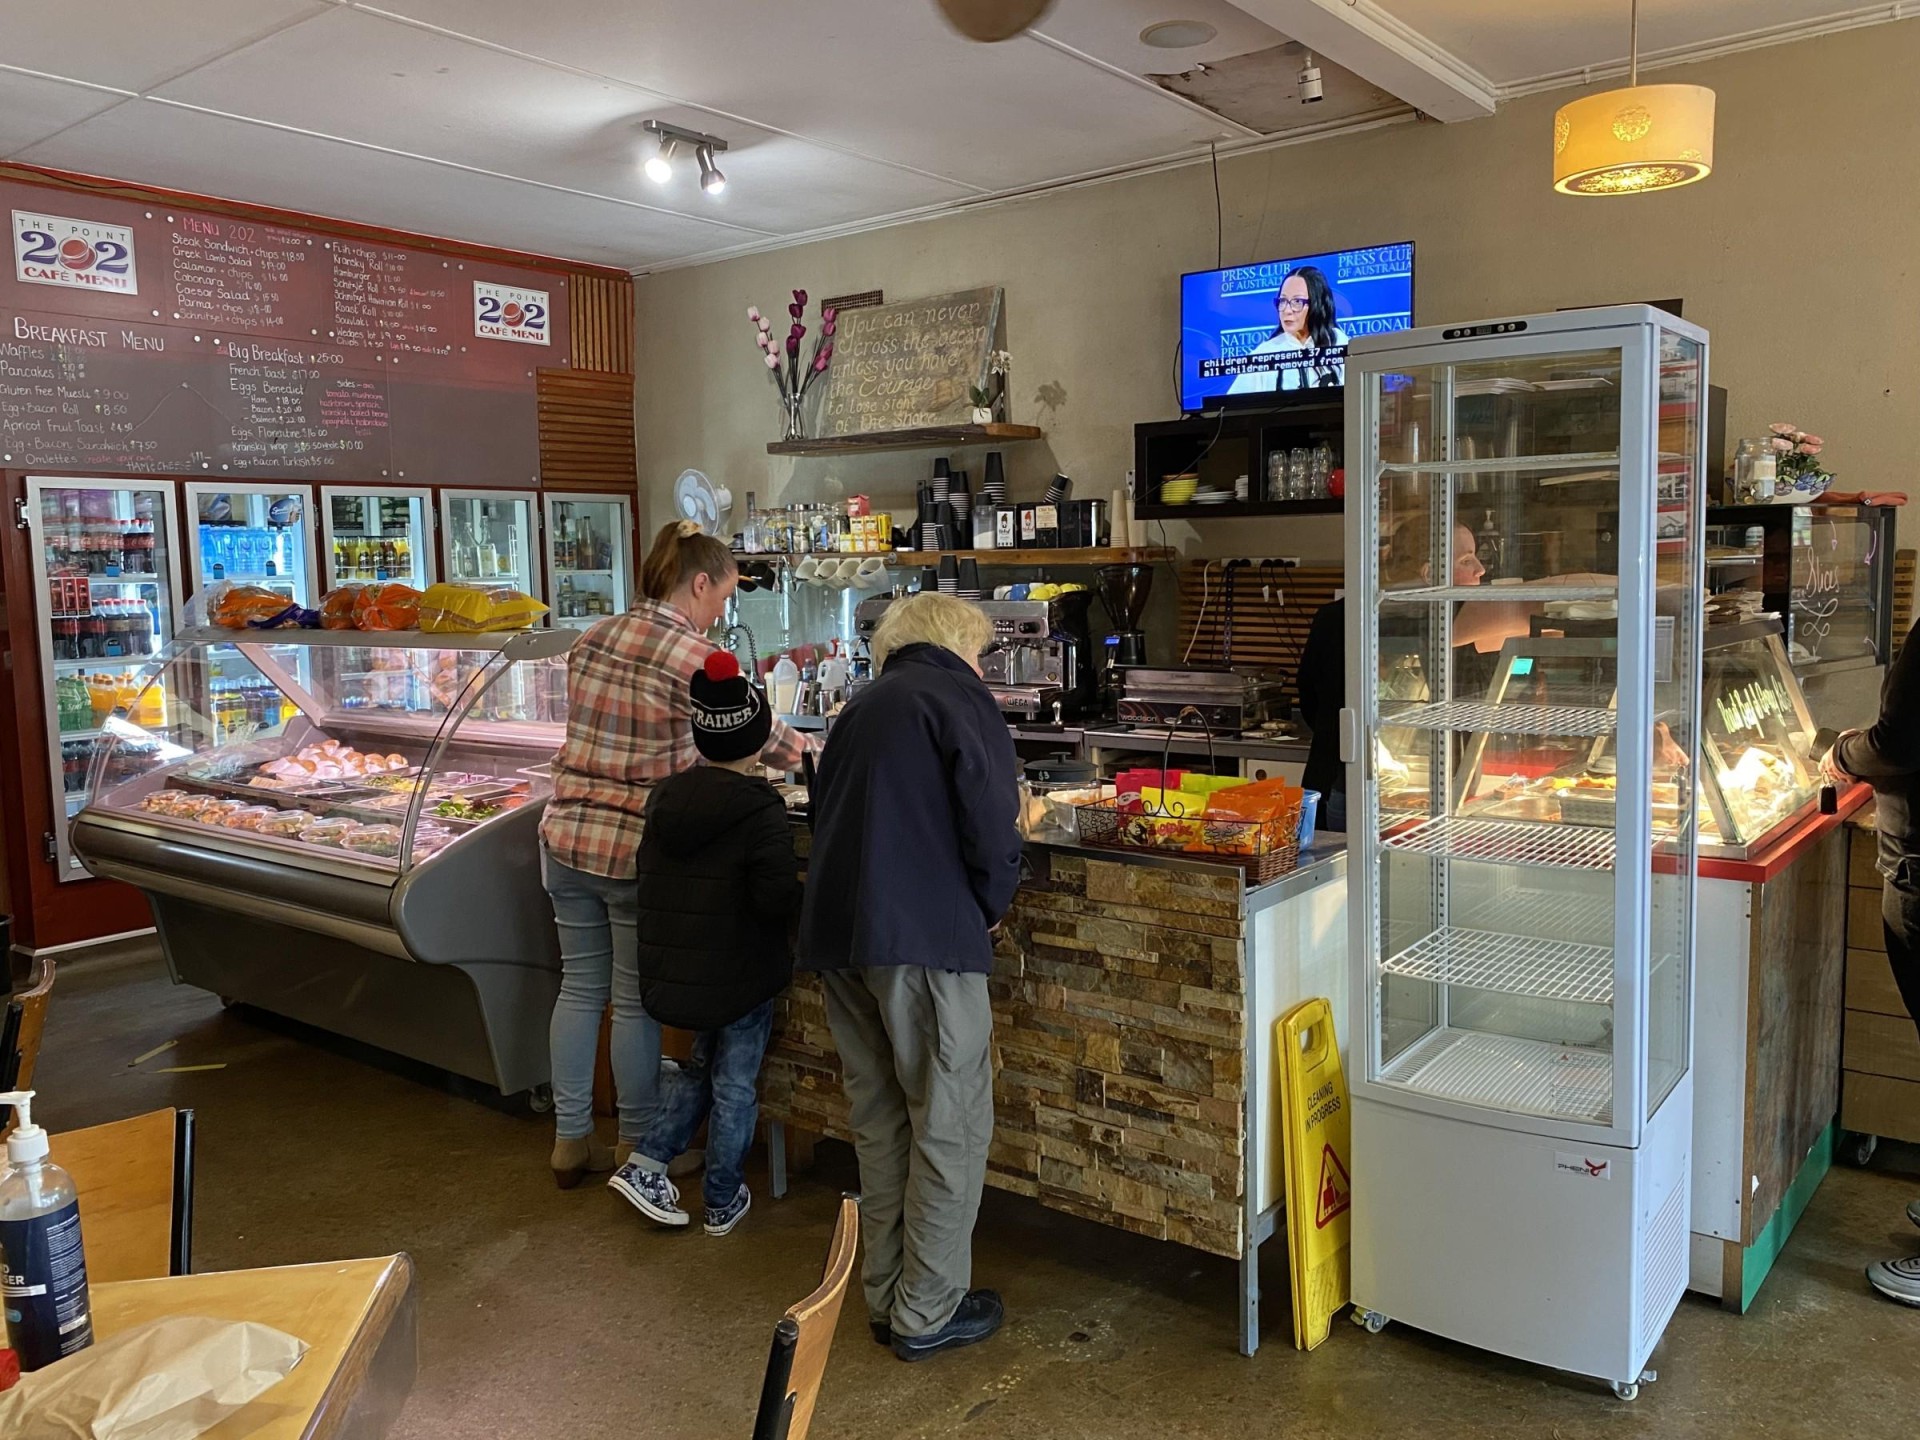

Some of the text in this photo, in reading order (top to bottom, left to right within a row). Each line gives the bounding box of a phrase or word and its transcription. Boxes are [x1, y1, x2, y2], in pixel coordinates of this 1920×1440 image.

[19, 219, 126, 241] THE POINT
[229, 225, 256, 243] 202
[172, 233, 201, 245] Steak
[204, 239, 250, 255] Sandwich
[255, 248, 279, 260] chips
[356, 248, 377, 260] chips
[173, 246, 252, 267] Greek Lamb Salad
[333, 254, 383, 273] Kransky Roll
[1338, 251, 1375, 268] PRESS
[24, 266, 127, 288] CAFÉ MENU
[228, 268, 254, 283] chips
[333, 266, 371, 284] Hamburger
[1222, 263, 1291, 282] PRESS CLUB
[1338, 267, 1351, 278] OF
[176, 283, 250, 301] Caesar Salad
[367, 283, 379, 294] Roll
[1221, 281, 1234, 292] OF
[478, 288, 544, 303] THE POINT
[178, 294, 243, 315] Parma chips
[335, 301, 377, 318] Roast Roll
[232, 317, 257, 330] chips
[884, 310, 914, 329] can
[925, 302, 980, 324] never
[14, 316, 164, 351] BREAKFAST MENU
[336, 327, 364, 340] Wedges
[480, 325, 544, 341] CAFÉ MENU
[1340, 319, 1411, 336] NATIONAL
[853, 325, 987, 356] cross the ocean
[228, 342, 249, 363] Big
[252, 344, 303, 366] Breakfast
[1203, 346, 1343, 368] children represent 37 per
[0, 360, 55, 379] Pancakes
[229, 363, 261, 377] French
[263, 366, 287, 379] Toast
[832, 352, 958, 379] unless you have
[1203, 357, 1343, 377] all children removed from
[0, 384, 32, 397] Gluten
[35, 385, 54, 397] Free
[230, 378, 304, 395] Eggs Benedict
[830, 376, 934, 399] the Courage
[251, 394, 268, 403] Ham
[828, 395, 916, 415] to lose sight
[62, 402, 79, 415] Roll
[251, 404, 274, 413] Bacon
[3, 419, 41, 435] Apricot
[47, 419, 73, 433] Fruit
[75, 419, 105, 434] Toast
[250, 414, 277, 423] Salmon
[835, 416, 851, 433] of
[231, 426, 254, 440] Eggs
[5, 437, 25, 453] Egg
[34, 437, 72, 449] Bacon
[77, 437, 130, 452] Sandwich
[232, 441, 266, 456] Kransky
[270, 443, 288, 454] wrap
[234, 457, 247, 468] Egg
[253, 457, 279, 466] Bacon
[281, 456, 311, 467] Turkish
[1007, 697, 1029, 706] WEGA
[1307, 1081, 1333, 1111] CLEANING
[1311, 1096, 1341, 1128] PROGRESS
